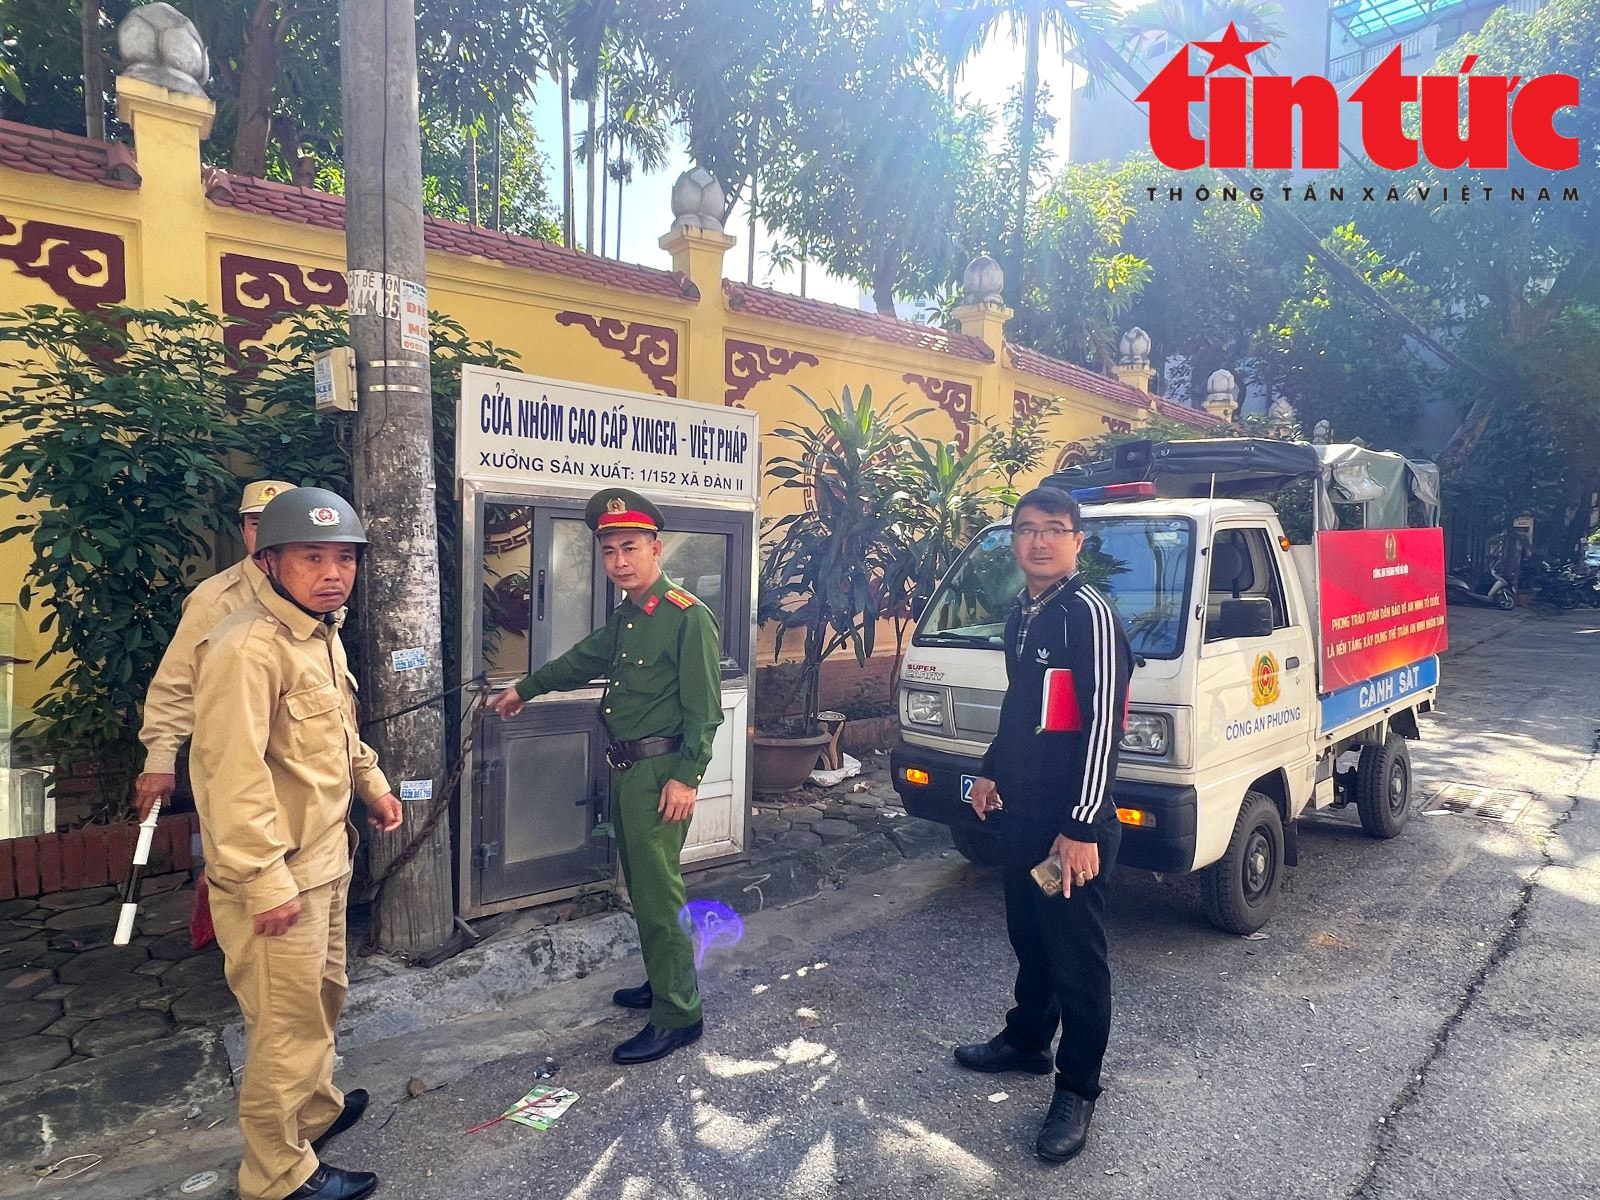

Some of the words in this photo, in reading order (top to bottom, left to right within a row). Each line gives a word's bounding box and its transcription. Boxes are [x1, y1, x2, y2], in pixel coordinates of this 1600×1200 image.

[480, 382, 513, 436] CỬA
[518, 394, 564, 442] NHÔM
[568, 406, 596, 446] CAO
[600, 404, 628, 449] CẤP
[631, 416, 678, 456] XINGFA
[690, 419, 715, 465] VIỆT
[717, 425, 748, 464] PHÁP
[479, 448, 544, 472] XƯỞNG
[550, 455, 584, 475] SẢN
[590, 460, 635, 480] XUẤT:
[640, 468, 677, 485] 1/152
[680, 471, 700, 487] XÃ
[703, 473, 732, 490] ĐÀN
[906, 670, 944, 680] CARRY
[1226, 720, 1251, 740] CÔNG
[1253, 716, 1265, 734] AN
[1267, 706, 1300, 728] PHƯỜNG
